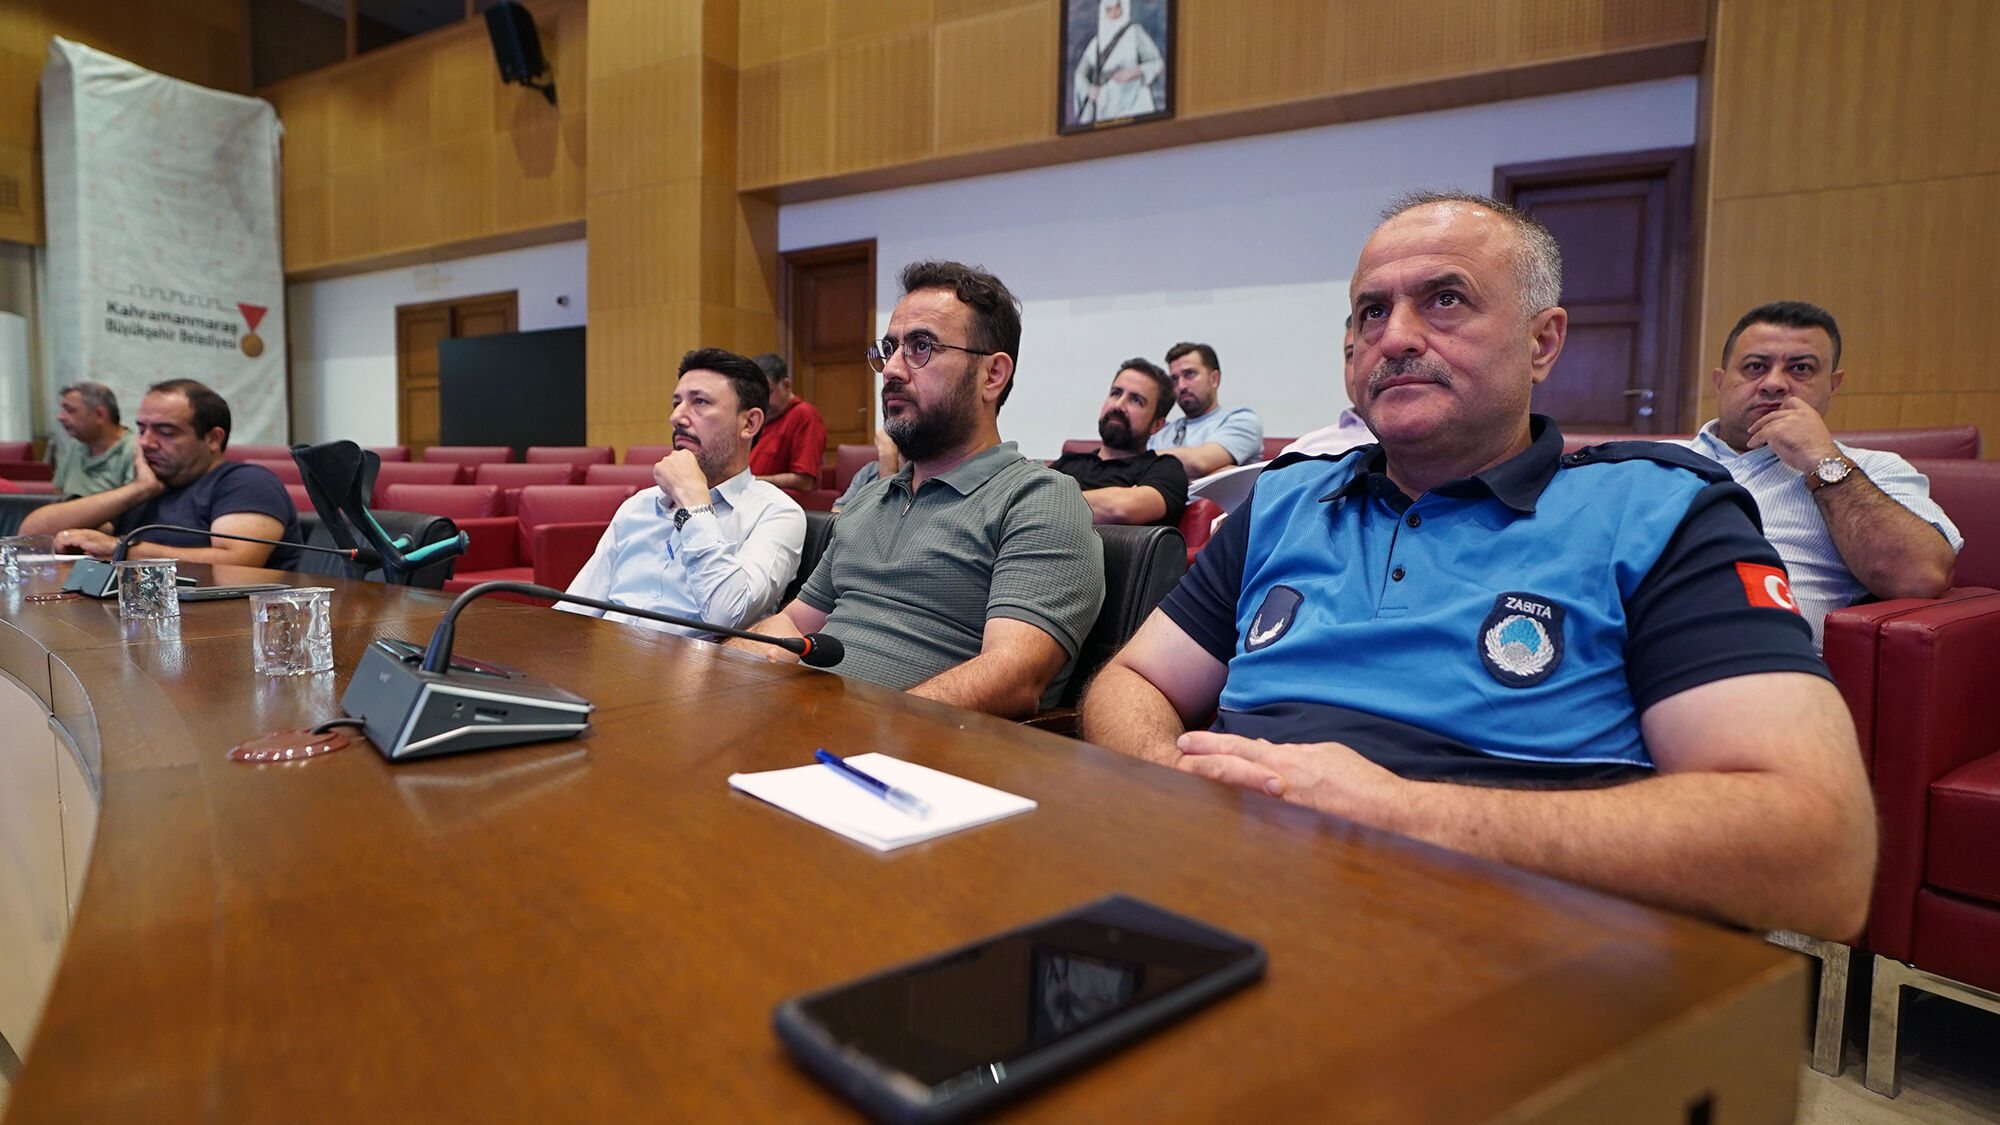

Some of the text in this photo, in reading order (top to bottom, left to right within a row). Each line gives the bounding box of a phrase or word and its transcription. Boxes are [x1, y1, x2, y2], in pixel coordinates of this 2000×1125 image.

[105, 318, 237, 349] Büyükşehir Belediyesi
[106, 301, 238, 335] Kahramanmaraş
[1504, 596, 1552, 619] ZABITA
